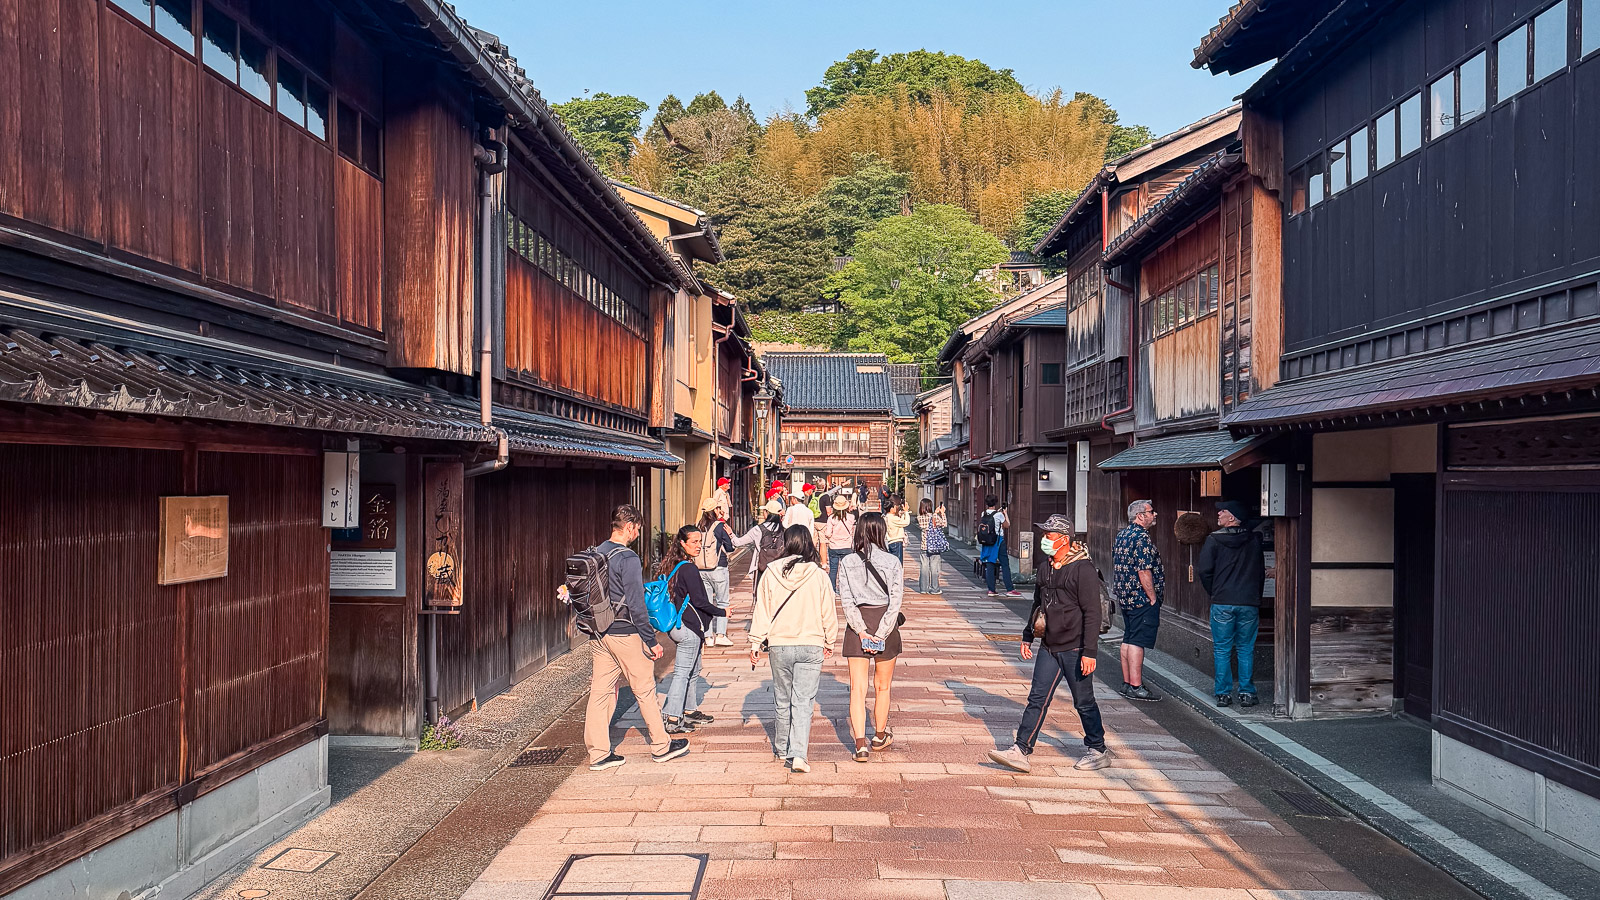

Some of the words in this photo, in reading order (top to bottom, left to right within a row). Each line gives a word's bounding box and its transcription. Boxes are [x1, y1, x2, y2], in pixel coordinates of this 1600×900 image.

[330, 487, 340, 522] ひがし
[366, 493, 391, 540] 金箔
